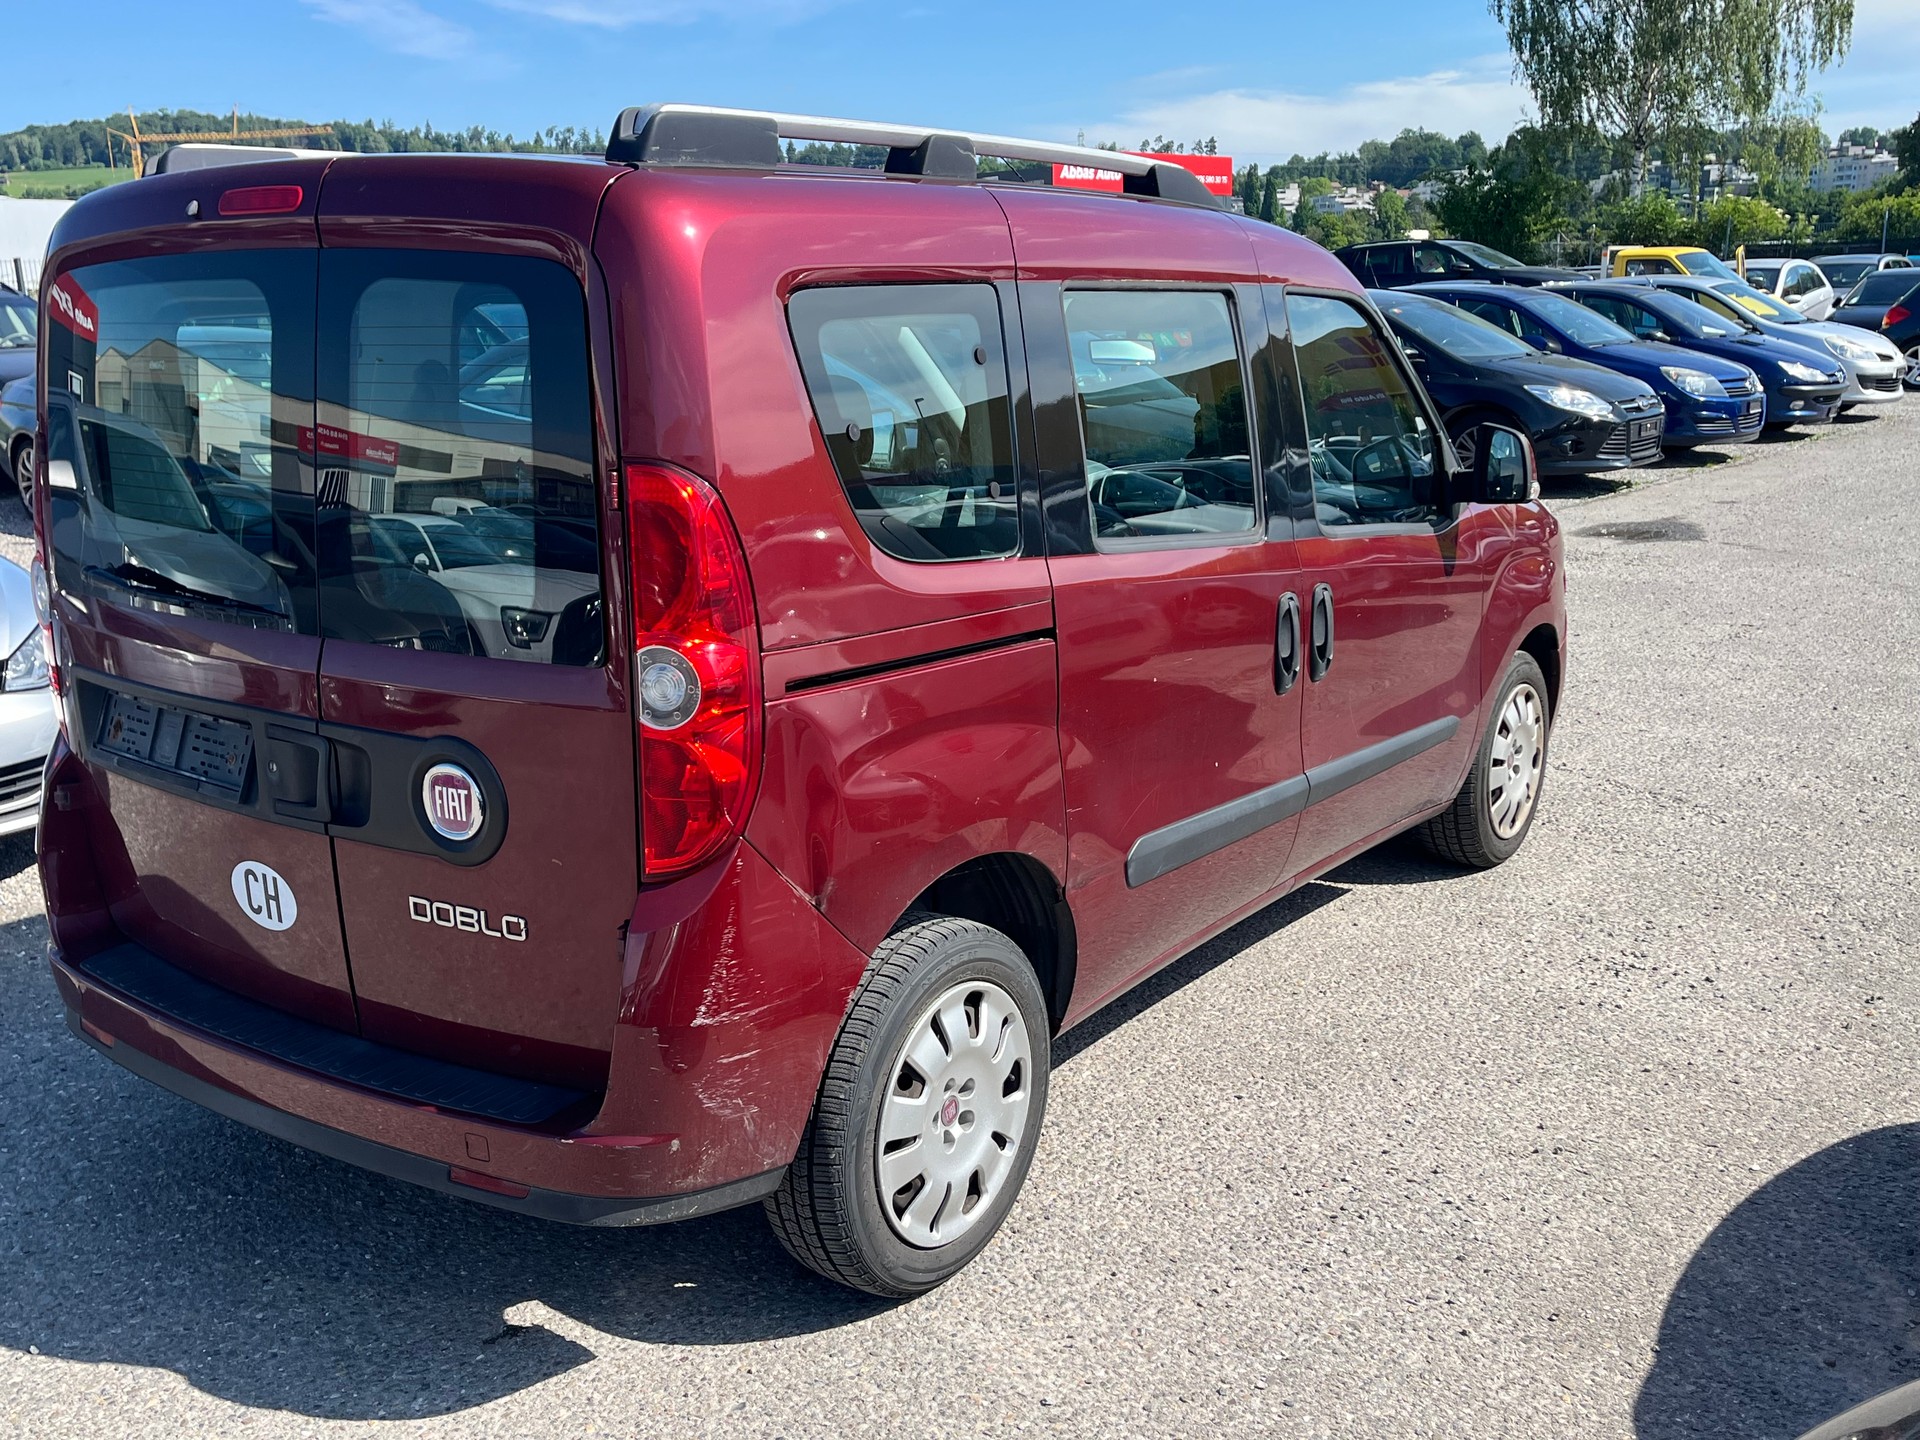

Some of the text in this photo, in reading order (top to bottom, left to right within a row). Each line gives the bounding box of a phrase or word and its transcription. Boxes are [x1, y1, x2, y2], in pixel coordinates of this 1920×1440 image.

[1060, 164, 1122, 181] Abbas Auto
[434, 785, 468, 822] FIAT
[243, 868, 284, 925] CH
